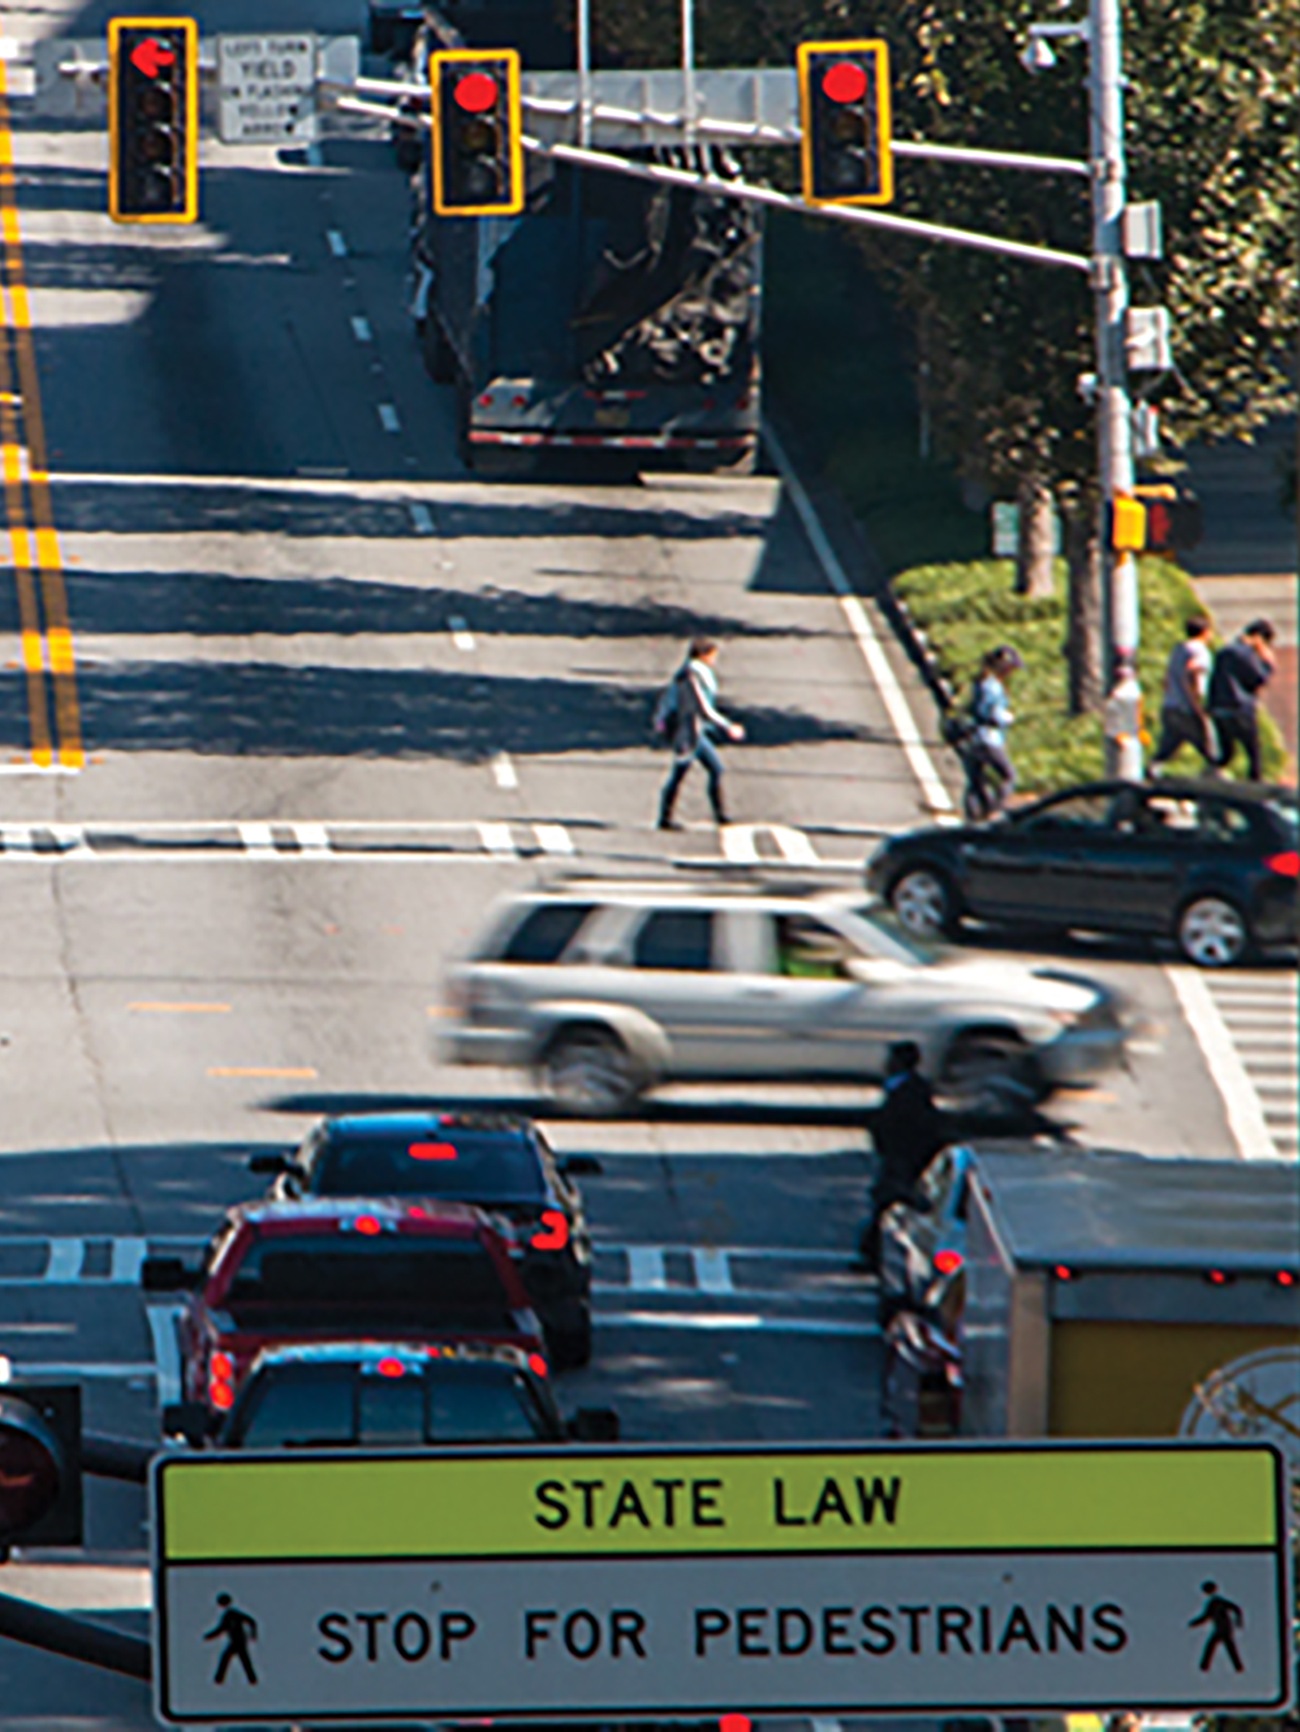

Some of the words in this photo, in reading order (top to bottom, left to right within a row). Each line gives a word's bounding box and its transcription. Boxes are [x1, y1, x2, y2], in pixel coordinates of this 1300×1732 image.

[241, 60, 296, 79] YIELD
[534, 1478, 726, 1530] STATE
[773, 1476, 901, 1527] LAW
[317, 1611, 477, 1663] STOP
[524, 1608, 647, 1660] FOR
[694, 1603, 1128, 1657] PEDESTRIANS
